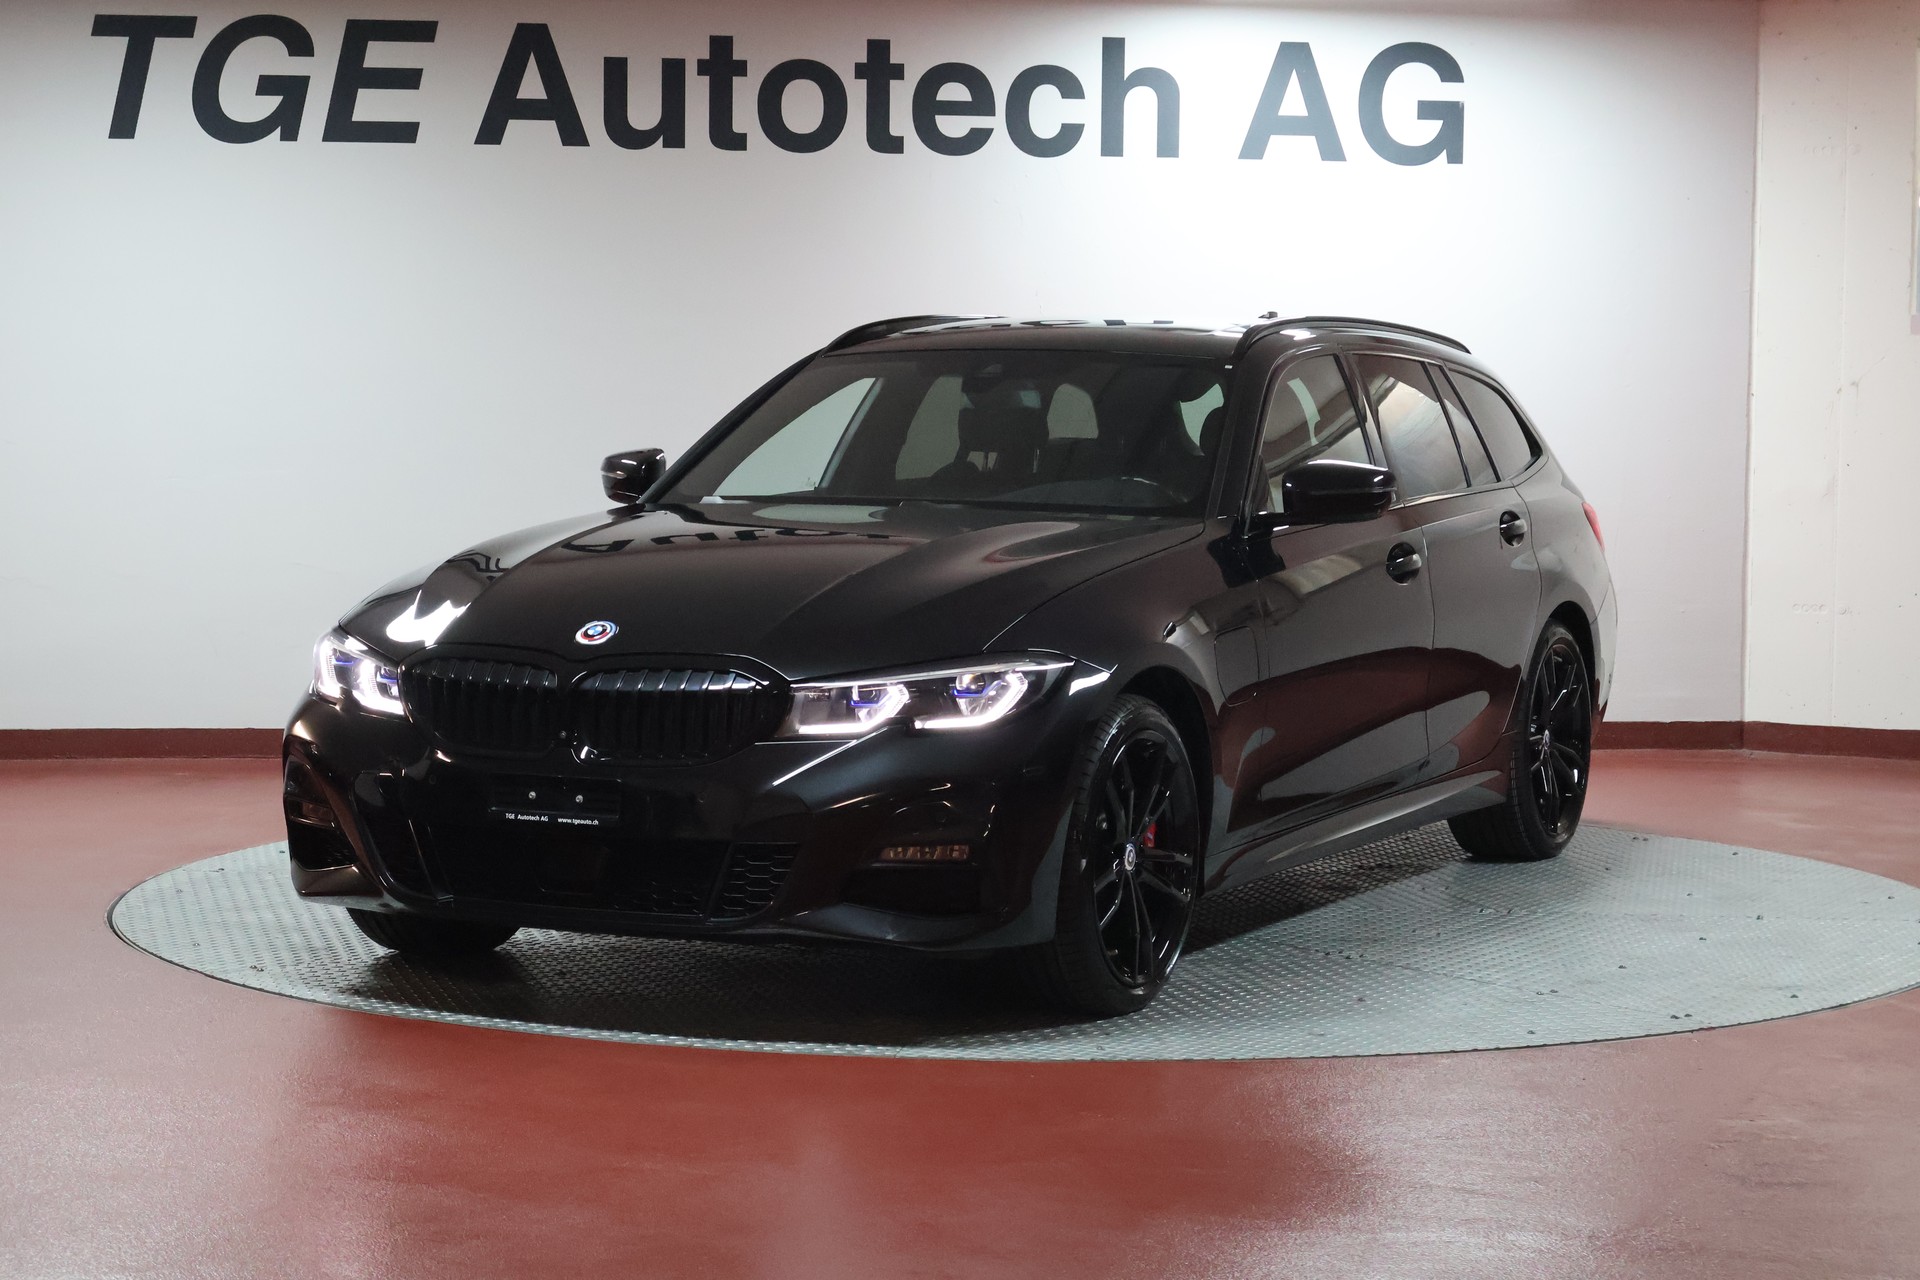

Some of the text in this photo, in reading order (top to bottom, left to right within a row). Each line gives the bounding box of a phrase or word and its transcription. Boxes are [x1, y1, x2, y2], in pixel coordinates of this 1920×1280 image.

[91, 13, 1466, 167] TGE Autotech AG
[505, 812, 516, 820] TGE
[517, 813, 540, 821] Autotech
[557, 817, 599, 826] www.tgeauto.ch
